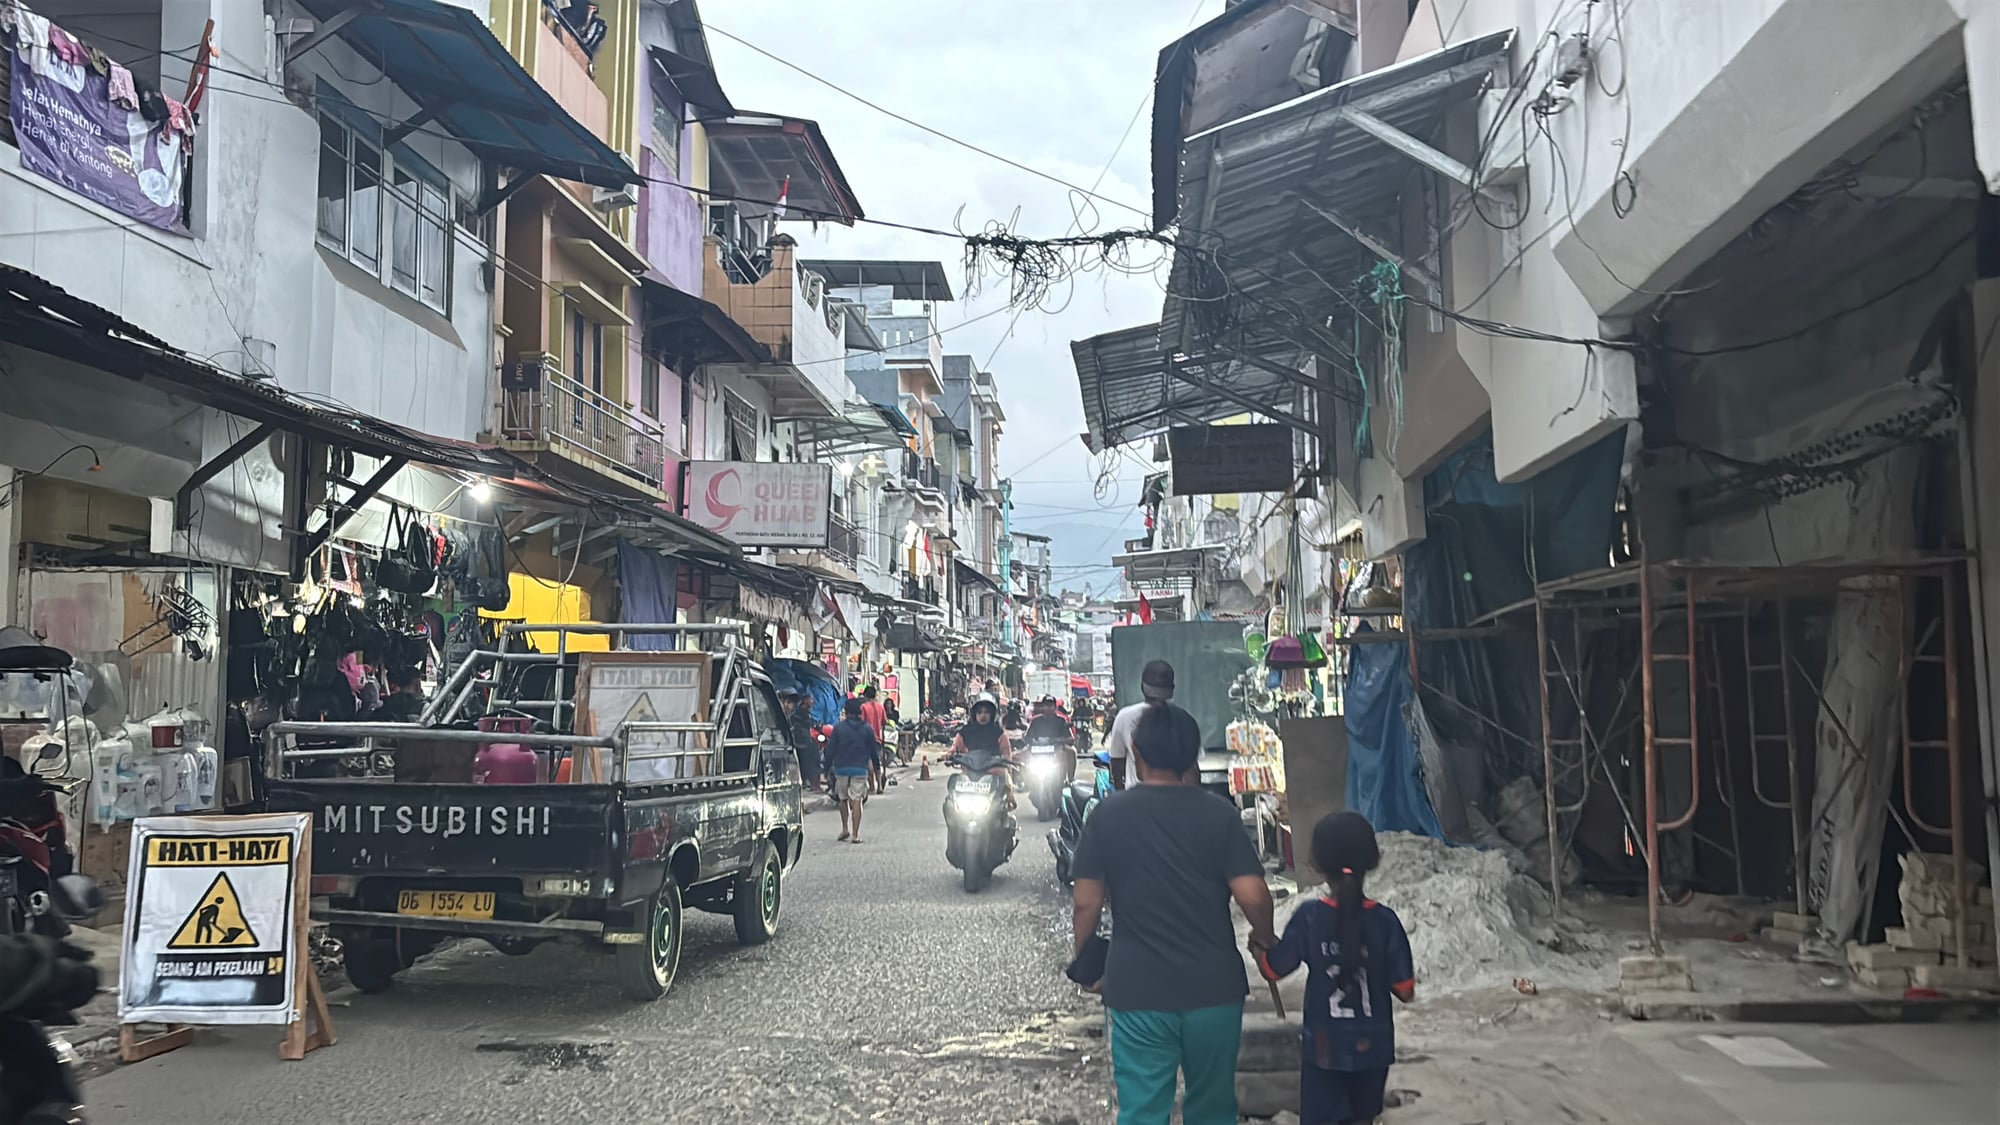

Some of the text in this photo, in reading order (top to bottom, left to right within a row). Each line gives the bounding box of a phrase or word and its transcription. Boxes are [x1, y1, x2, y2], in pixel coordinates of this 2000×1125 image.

[21, 84, 102, 136] Jelas Hematnya
[22, 101, 58, 129] Hemat
[21, 119, 58, 148] Hemat
[754, 504, 817, 522] HIJAB
[325, 805, 550, 836] MITSUBISHI
[158, 839, 281, 862] HATI-HATI
[430, 893, 464, 911] 1554
[473, 893, 493, 911] LU
[155, 960, 265, 977] SEDANG ADA PEKERJAAN
